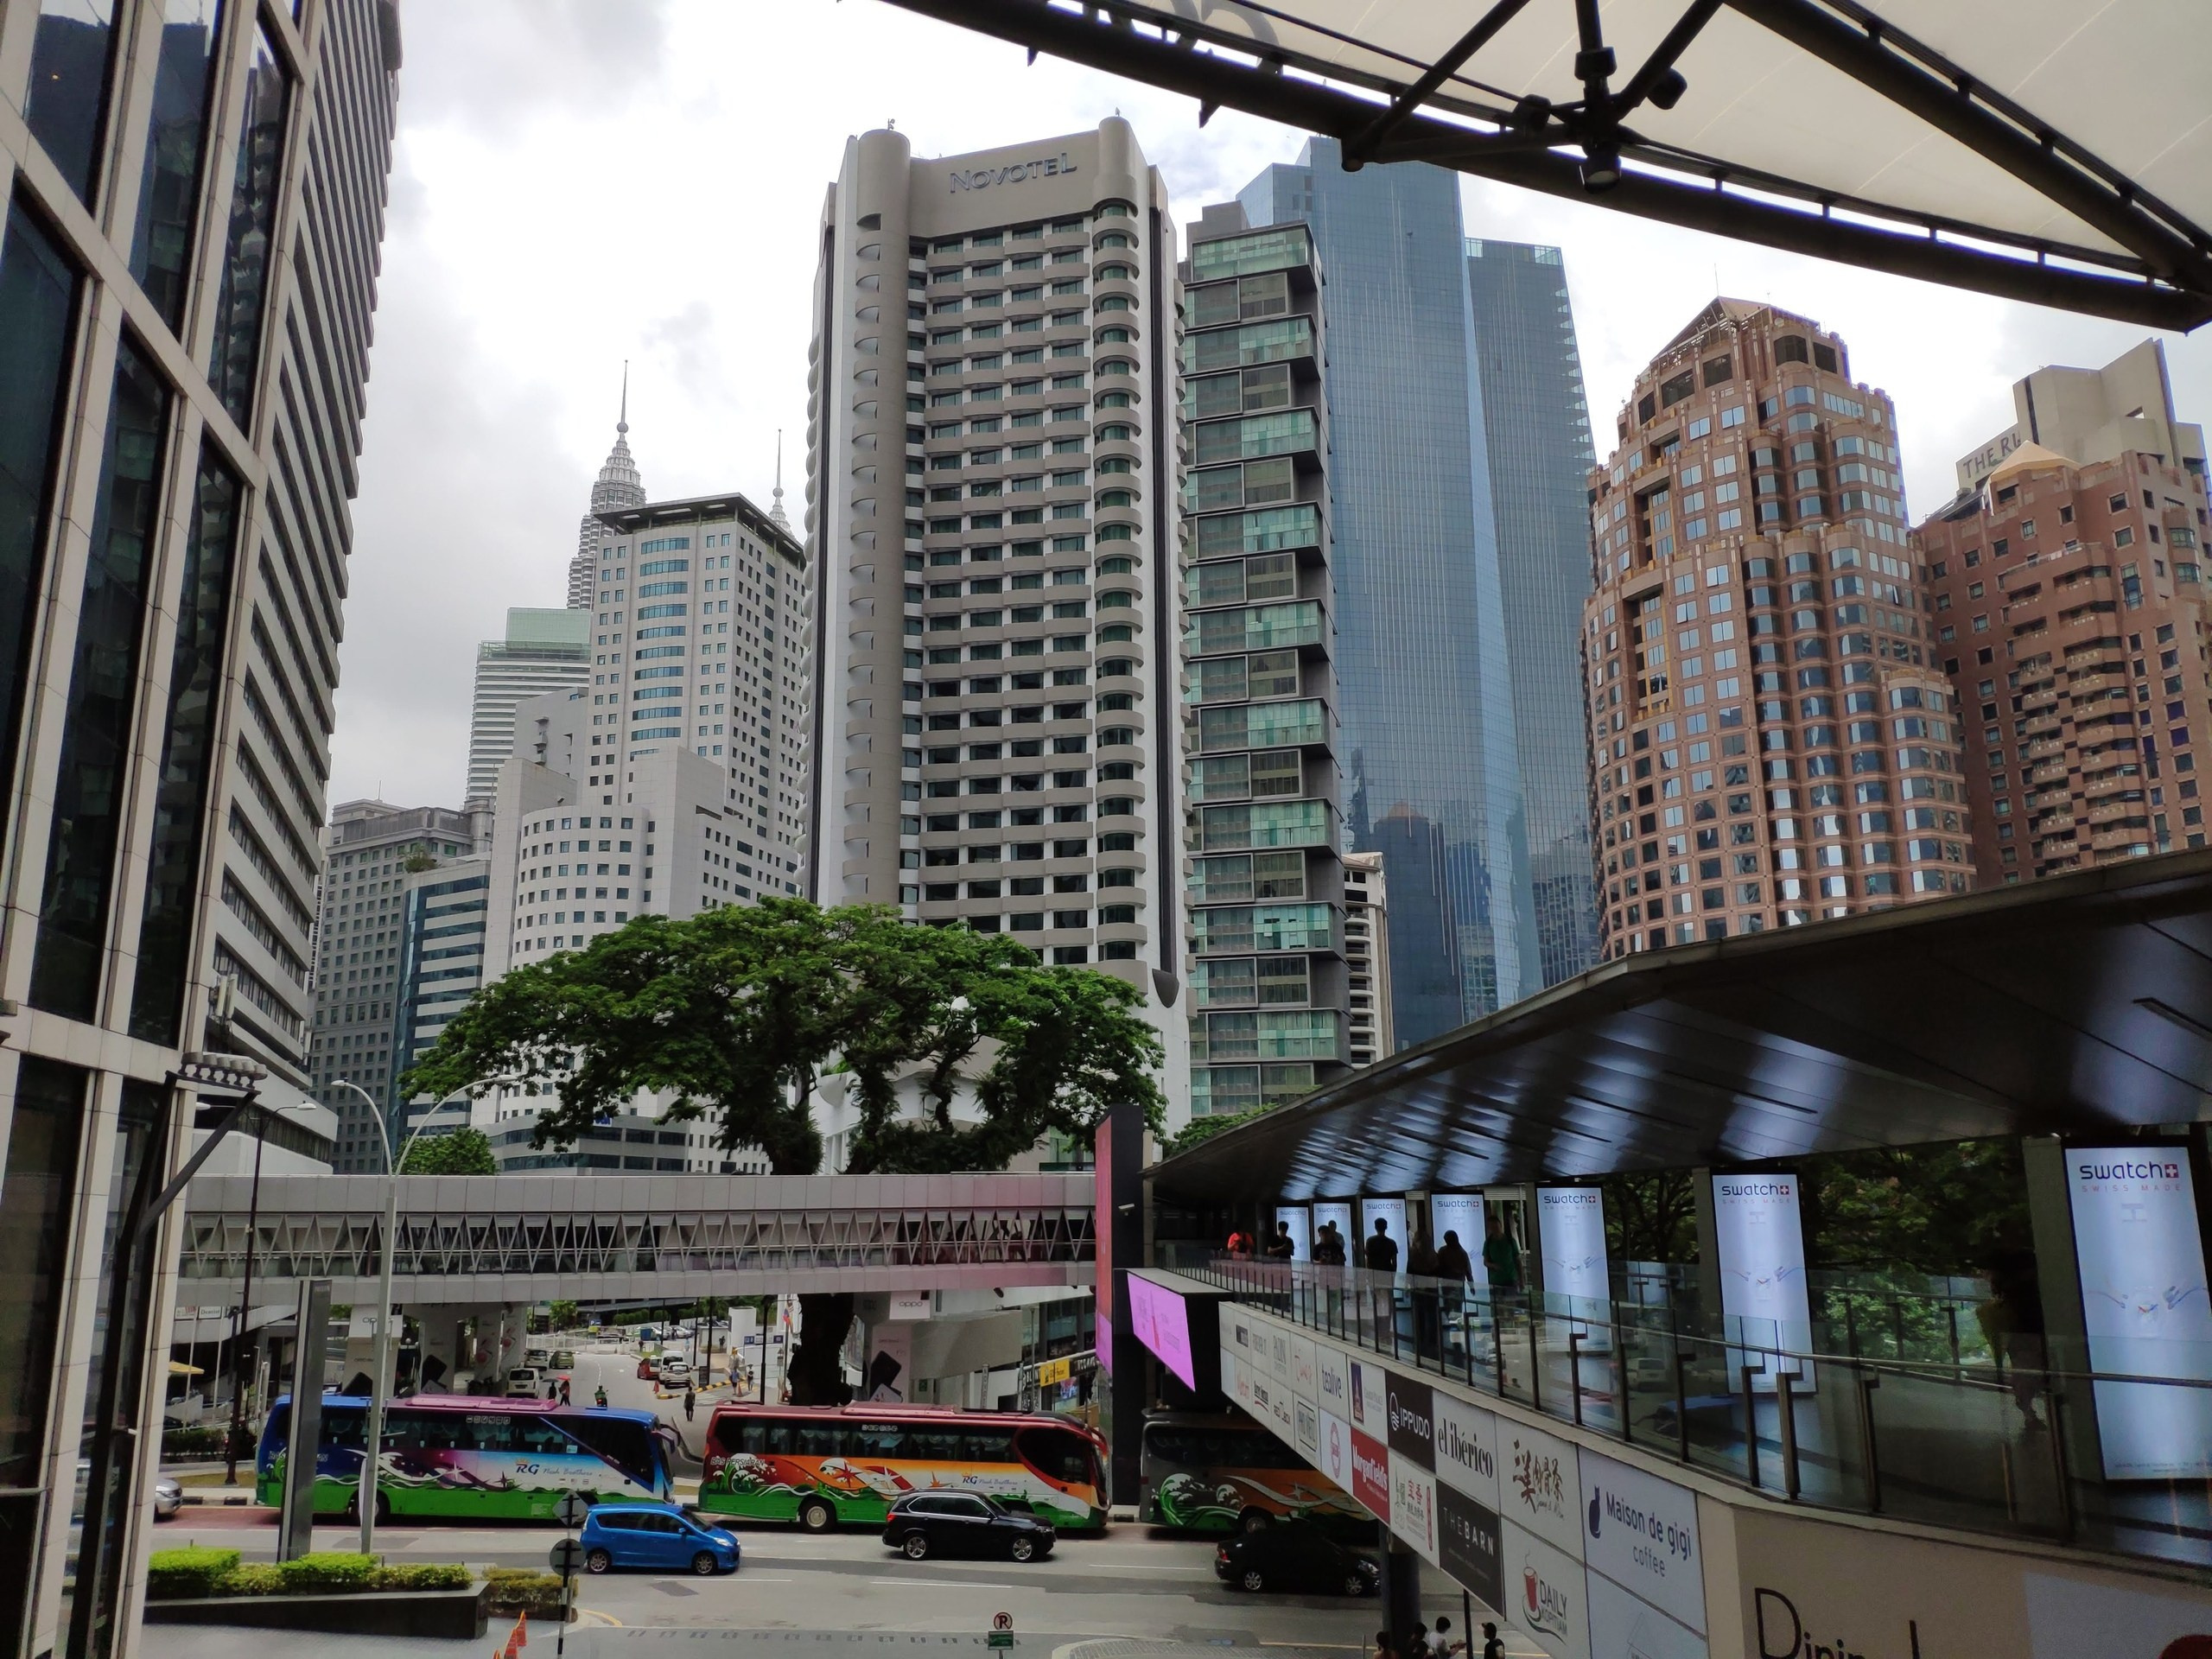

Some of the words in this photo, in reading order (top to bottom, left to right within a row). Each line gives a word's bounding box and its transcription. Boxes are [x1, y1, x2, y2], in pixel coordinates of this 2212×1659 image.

[950, 153, 1077, 194] NOVOTEL
[1963, 448, 1994, 478] THE
[2080, 1161, 2163, 1180] swatch
[1543, 1194, 1588, 1204] swatch
[1721, 1183, 1779, 1196] swatch
[2082, 1184, 2129, 1193] SWISS
[2141, 1183, 2182, 1192] MADE
[1438, 1199, 1473, 1208] swatch
[1321, 1363, 1342, 1399] tealive
[1400, 1408, 1430, 1440] IPPUDO
[1438, 1417, 1448, 1456] el
[1449, 1421, 1494, 1479] ibérico
[516, 1463, 540, 1475] RG
[710, 1457, 726, 1465] BAS
[726, 1457, 766, 1466] PERSIARAN
[963, 1475, 978, 1484] RG
[1605, 1491, 1645, 1535] Maison
[1649, 1512, 1663, 1543] de
[1668, 1522, 1692, 1561] gigi
[1632, 1545, 1666, 1578] coffee
[1539, 1579, 1567, 1620] DAILY
